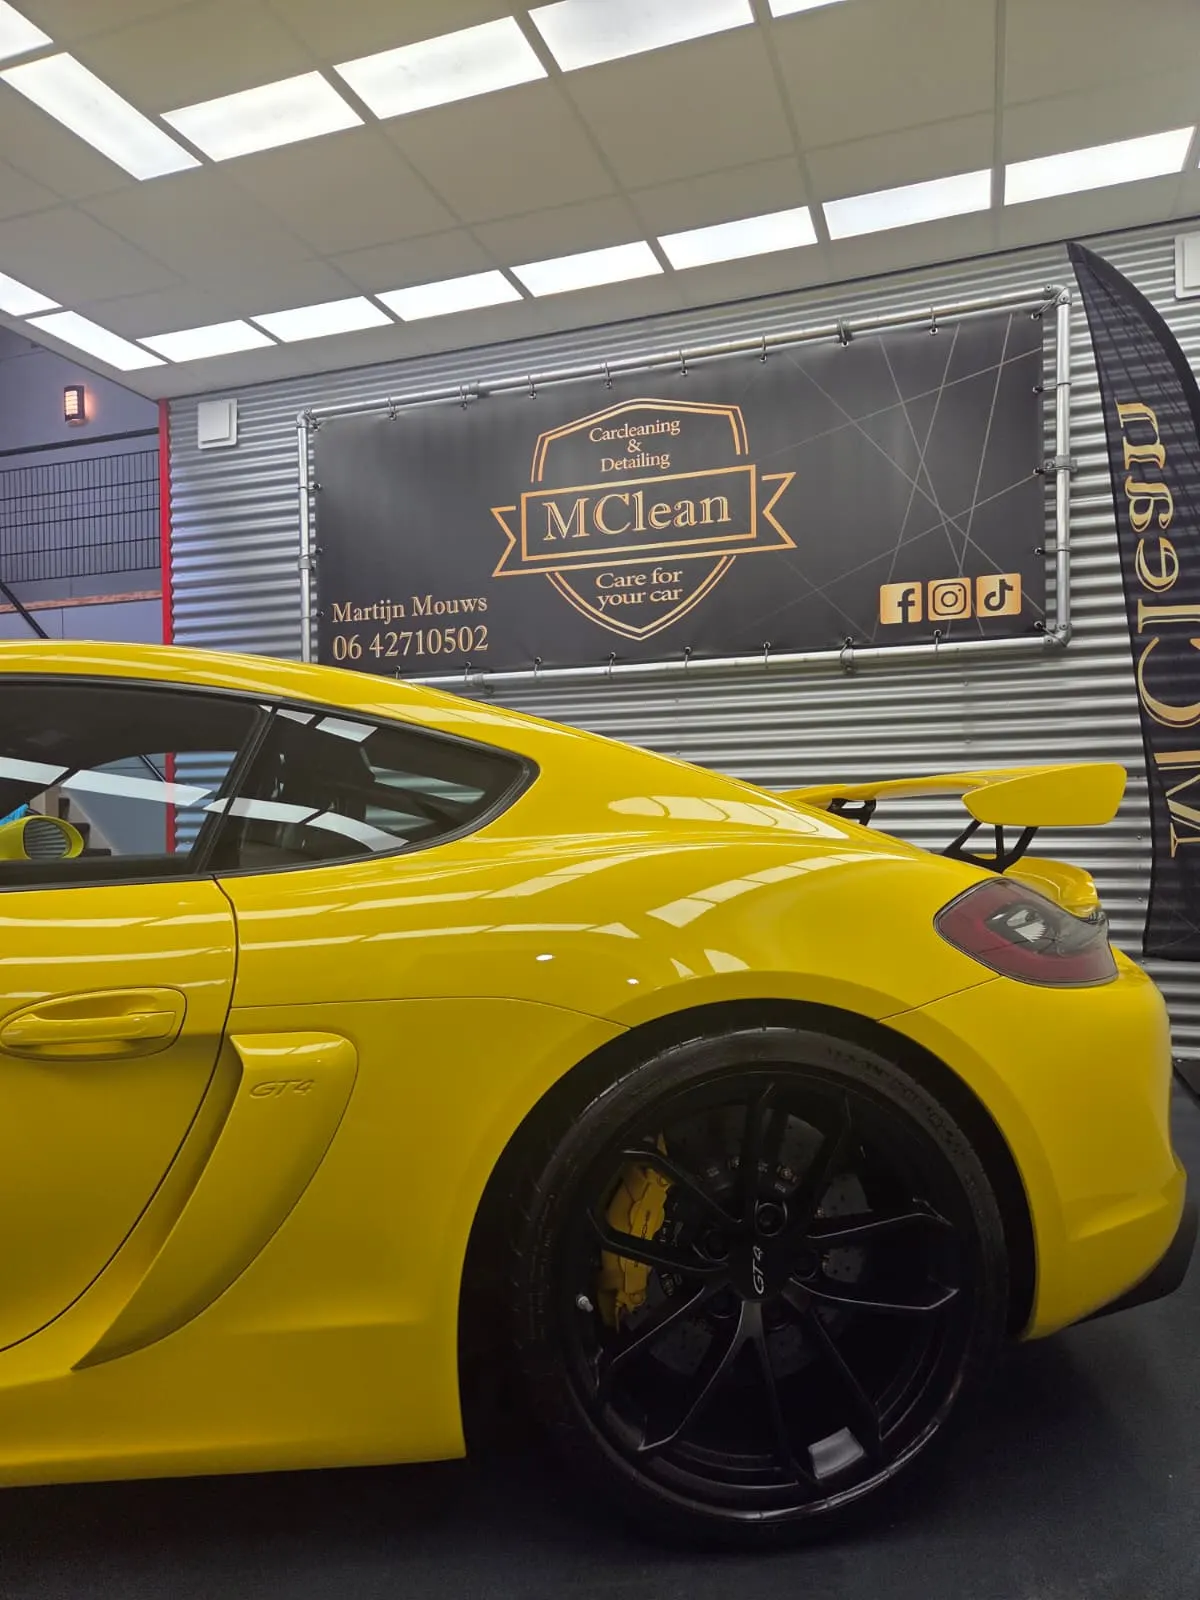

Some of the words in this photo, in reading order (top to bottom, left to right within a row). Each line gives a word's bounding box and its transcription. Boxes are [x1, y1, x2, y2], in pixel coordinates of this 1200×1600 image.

[590, 419, 680, 441] Carcleaning
[627, 439, 642, 453] &
[600, 452, 671, 473] Detailing
[543, 491, 731, 540] MClean
[595, 572, 647, 590] Care
[652, 567, 684, 585] for
[332, 599, 405, 625] Martijn
[411, 594, 488, 617] Mouws
[596, 590, 647, 612] your
[650, 586, 684, 602] car
[332, 634, 362, 661] 06
[368, 625, 489, 659] 42710502
[249, 1079, 315, 1099] GT4
[752, 1245, 765, 1295] GT4
